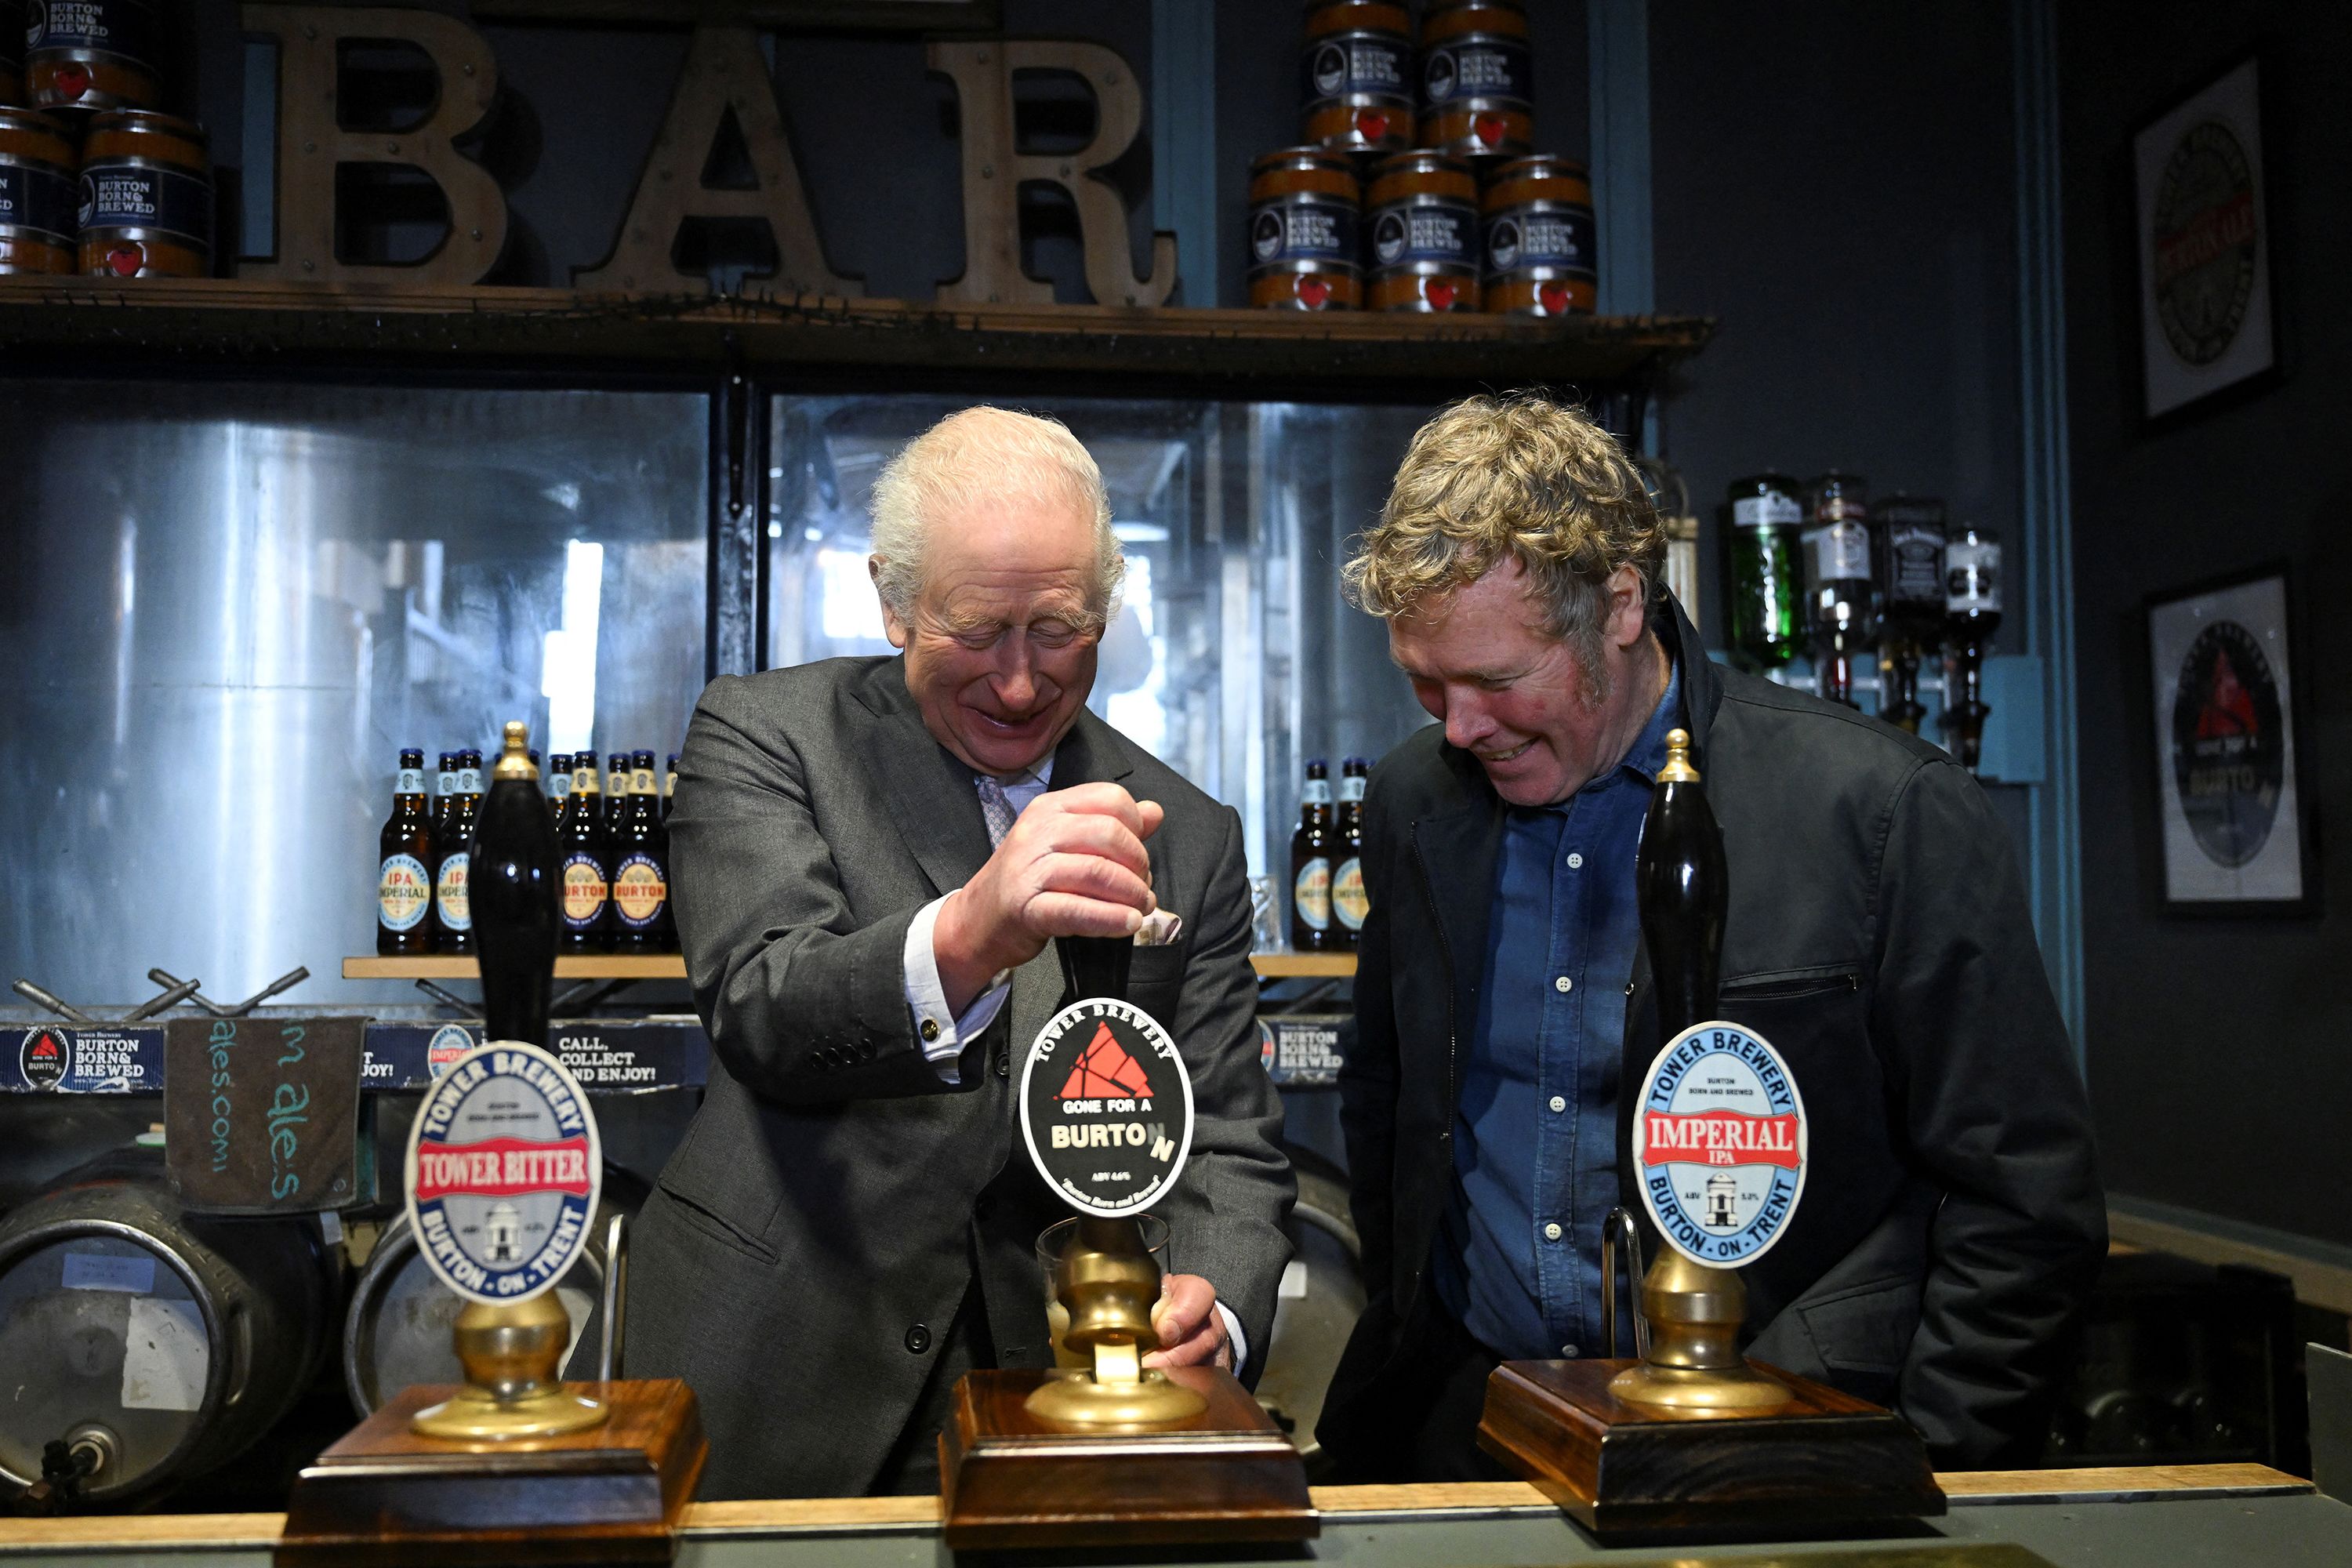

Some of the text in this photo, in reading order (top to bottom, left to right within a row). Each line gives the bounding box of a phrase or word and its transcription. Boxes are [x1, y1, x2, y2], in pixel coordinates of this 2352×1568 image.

[50, 3, 103, 16] BURTON
[50, 23, 108, 37] BREWED
[237, 5, 1177, 307] BAR
[98, 181, 151, 193] BURTON
[98, 201, 155, 214] BREWED
[389, 873, 412, 886] IPA
[379, 887, 426, 898] MPERIAL
[564, 885, 605, 897] URTON
[615, 885, 664, 897] BURTON
[1035, 1004, 1173, 1062] TOWER BREWERY
[1279, 1031, 1338, 1045] BURTON
[76, 1039, 140, 1052] BURTON
[558, 1037, 608, 1051] CALL,
[558, 1052, 635, 1066] COLLECT
[1279, 1054, 1343, 1068] BREWED
[74, 1064, 145, 1077] BREWED
[361, 1064, 394, 1077] JOY!
[573, 1067, 656, 1081] ND ENJOY!
[1651, 1032, 1791, 1107] TOWER BREWERY
[423, 1051, 584, 1134] TOWER BREWERY
[1062, 1098, 1152, 1114] GONE FOR A
[1649, 1117, 1794, 1152] IMPERIAL
[1708, 1149, 1735, 1165] IPA
[419, 1148, 586, 1187] TOWER BITTER
[1650, 1175, 1792, 1256] BURTON ON TRENT
[421, 1205, 583, 1295] BURTON ON TRENT
